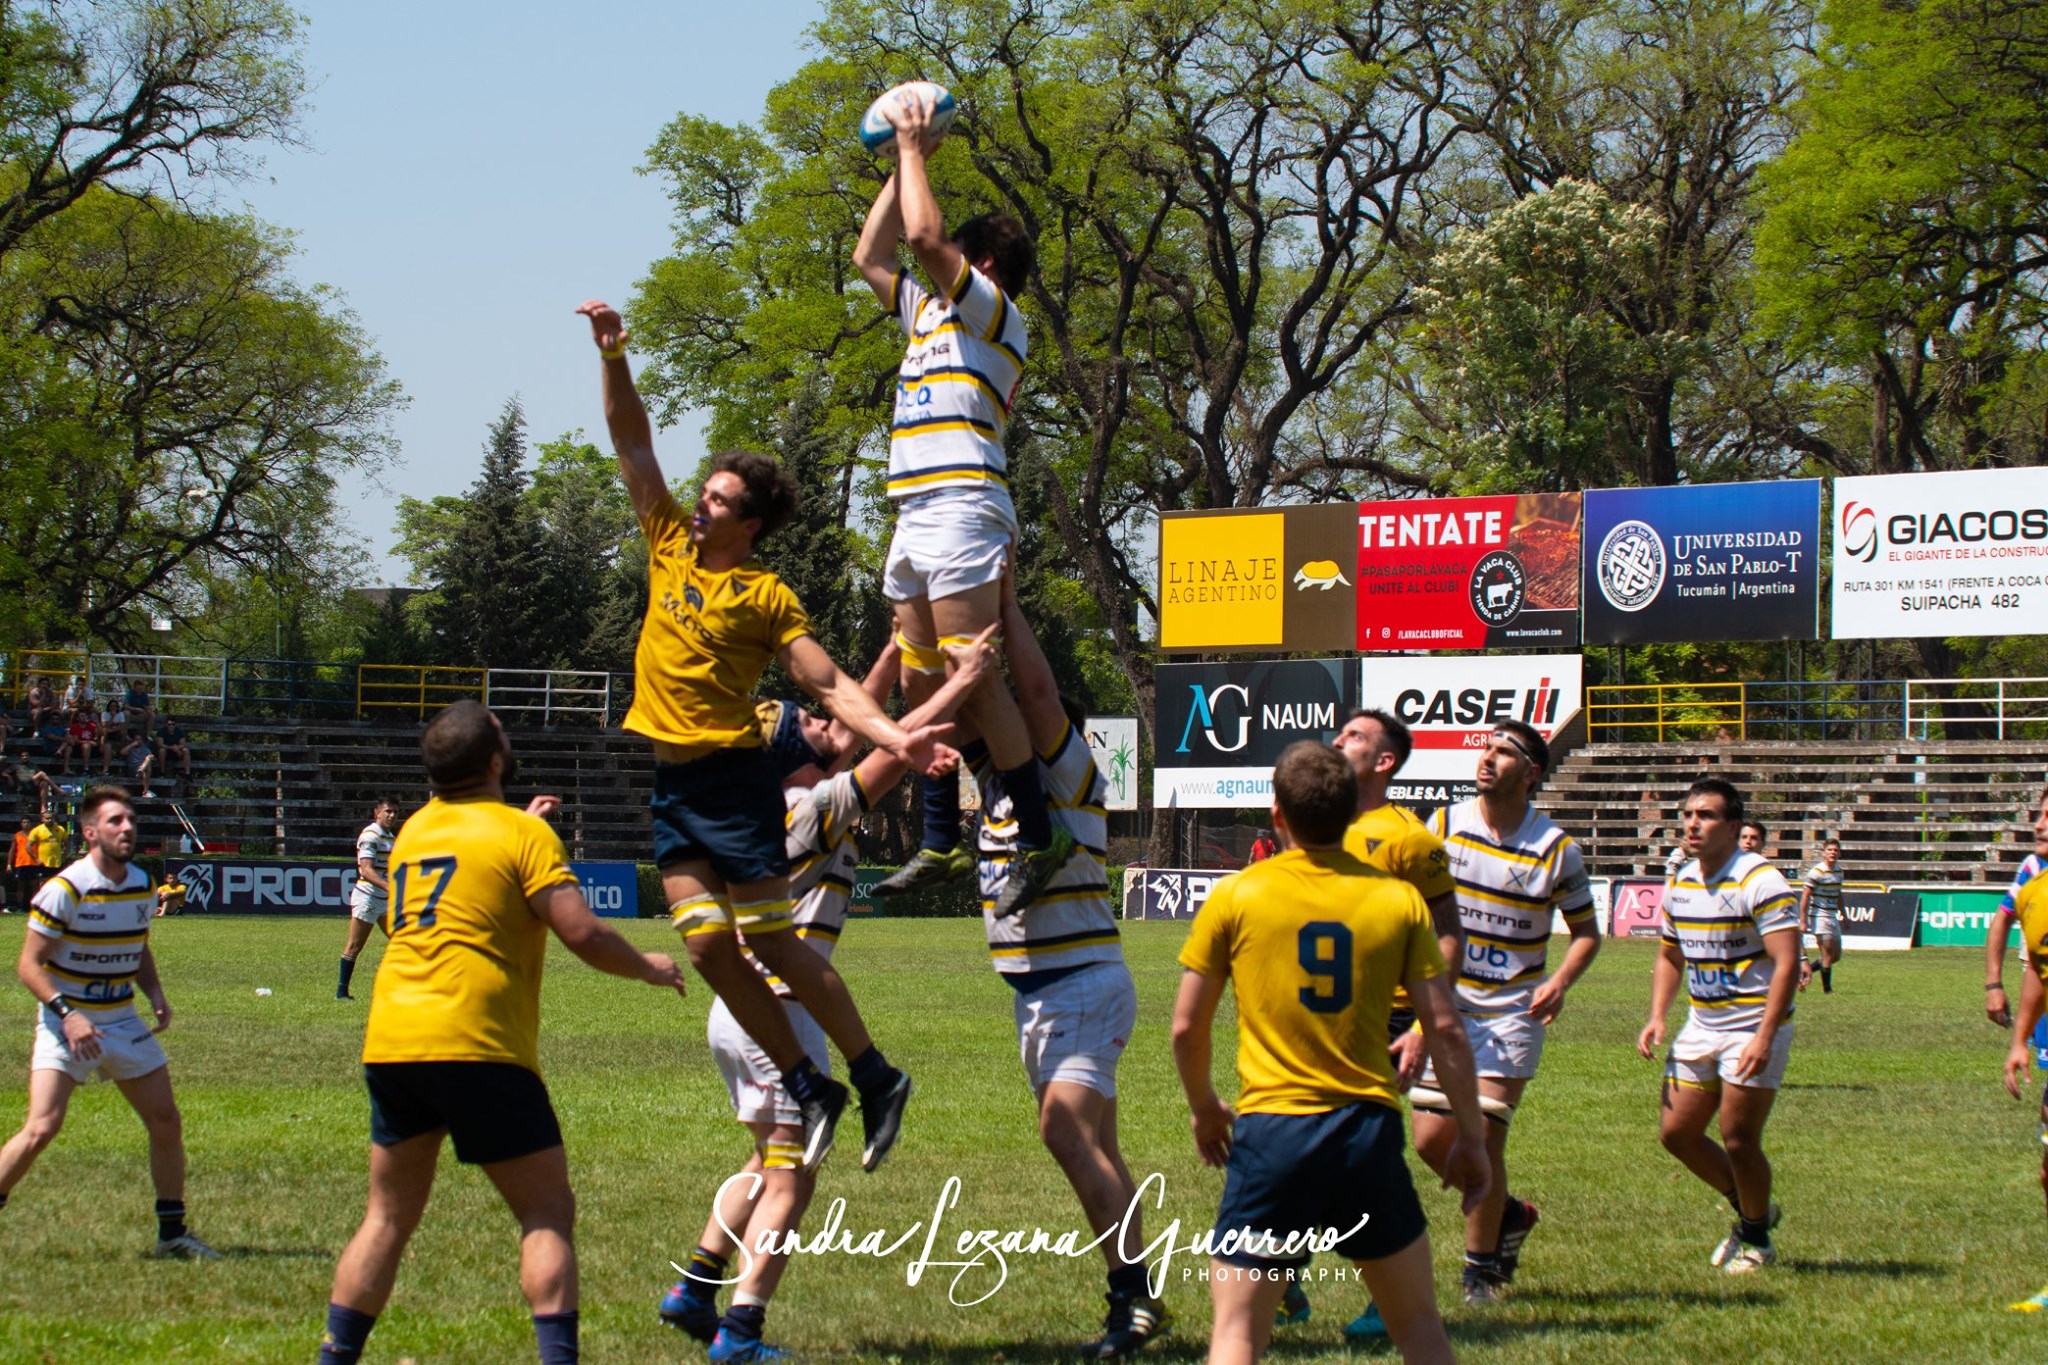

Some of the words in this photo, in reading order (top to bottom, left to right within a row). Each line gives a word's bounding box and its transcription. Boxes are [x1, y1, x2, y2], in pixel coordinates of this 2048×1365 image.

[1359, 511, 1502, 548] TENTATE
[1889, 551, 1901, 562] EL
[1904, 549, 1952, 561] GIGANTE
[1955, 549, 1970, 559] DE
[1973, 548, 1986, 558] LA
[1168, 558, 1277, 584] LINAJE
[1361, 563, 1468, 577] #PASAPORLAVACA
[1474, 576, 1484, 588] LA
[1480, 558, 1504, 574] VACA
[1505, 560, 1523, 586] CLUB
[1168, 584, 1277, 604] AGENTINO
[1369, 582, 1403, 595] UNITE
[1406, 581, 1422, 594] AL
[1425, 580, 1460, 593] CLUB!
[1676, 583, 1726, 597] Tucumán
[1738, 581, 1795, 598] Argentina
[1843, 581, 1871, 593] RUTA
[1874, 580, 1893, 591] 301
[1897, 579, 1915, 590] KM
[1918, 579, 1944, 590] 1541
[1947, 576, 1994, 591] (FRENTE
[1996, 576, 2006, 587] A
[2008, 575, 2042, 587] COCA
[1901, 595, 1982, 611] SUIPACHA
[1991, 593, 2020, 609] 482
[1505, 628, 1562, 637] www.lavacaclub.com
[1175, 683, 1253, 753] AG
[1262, 702, 1335, 730] NAUM
[1395, 689, 1516, 725] CASE
[393, 856, 458, 931] 17
[1298, 921, 1353, 1014] 9
